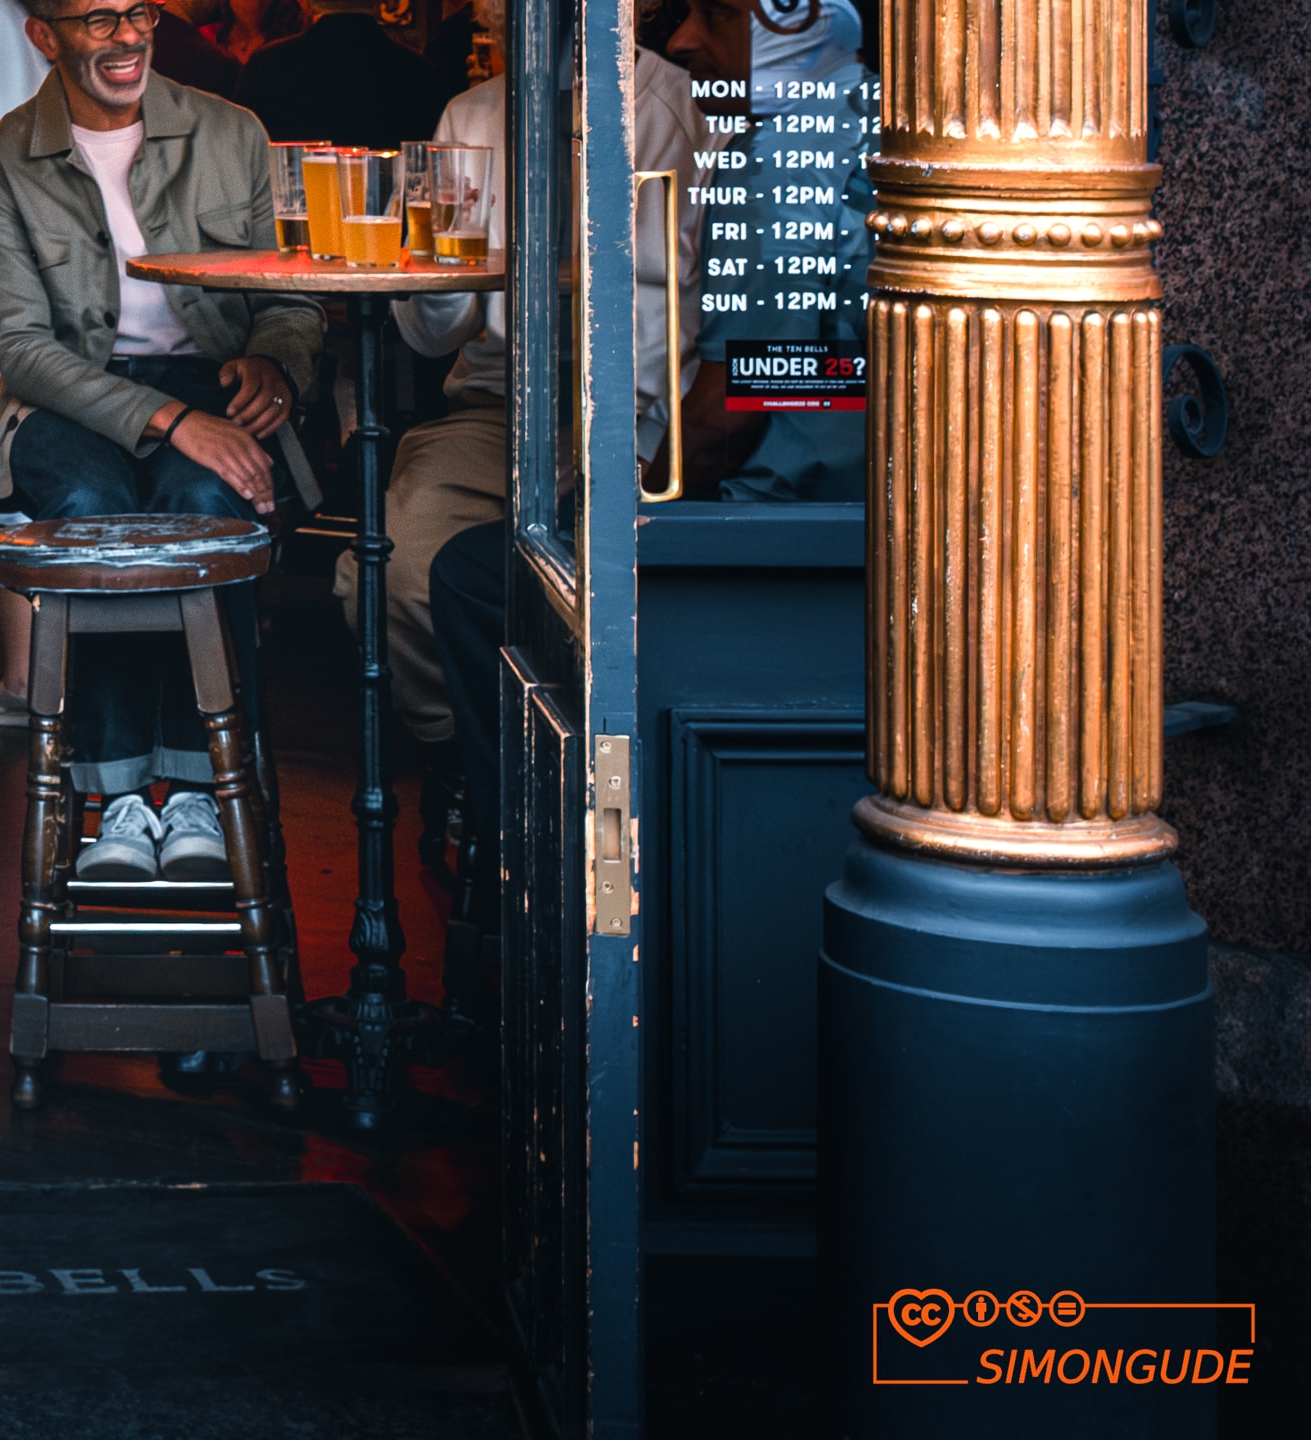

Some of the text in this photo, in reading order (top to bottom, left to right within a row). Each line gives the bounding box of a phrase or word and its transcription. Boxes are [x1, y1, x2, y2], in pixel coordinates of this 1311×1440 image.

[691, 80, 746, 98] MON
[774, 81, 836, 99] 12PM
[705, 116, 747, 134] TUE
[773, 115, 835, 133] 12PM
[693, 151, 747, 169] WED
[772, 150, 834, 169] 12PM
[687, 186, 747, 205] THUR
[772, 185, 834, 205] 12PM
[711, 222, 747, 240] FRI
[771, 221, 833, 240] 12PM
[707, 258, 748, 276] SAT
[774, 256, 836, 274] 12PM
[701, 293, 747, 312] SUN
[774, 291, 836, 310] 12PM
[766, 345, 829, 353] THE TEN BELLS
[740, 357, 818, 376] UNDER
[824, 357, 866, 376] 25?
